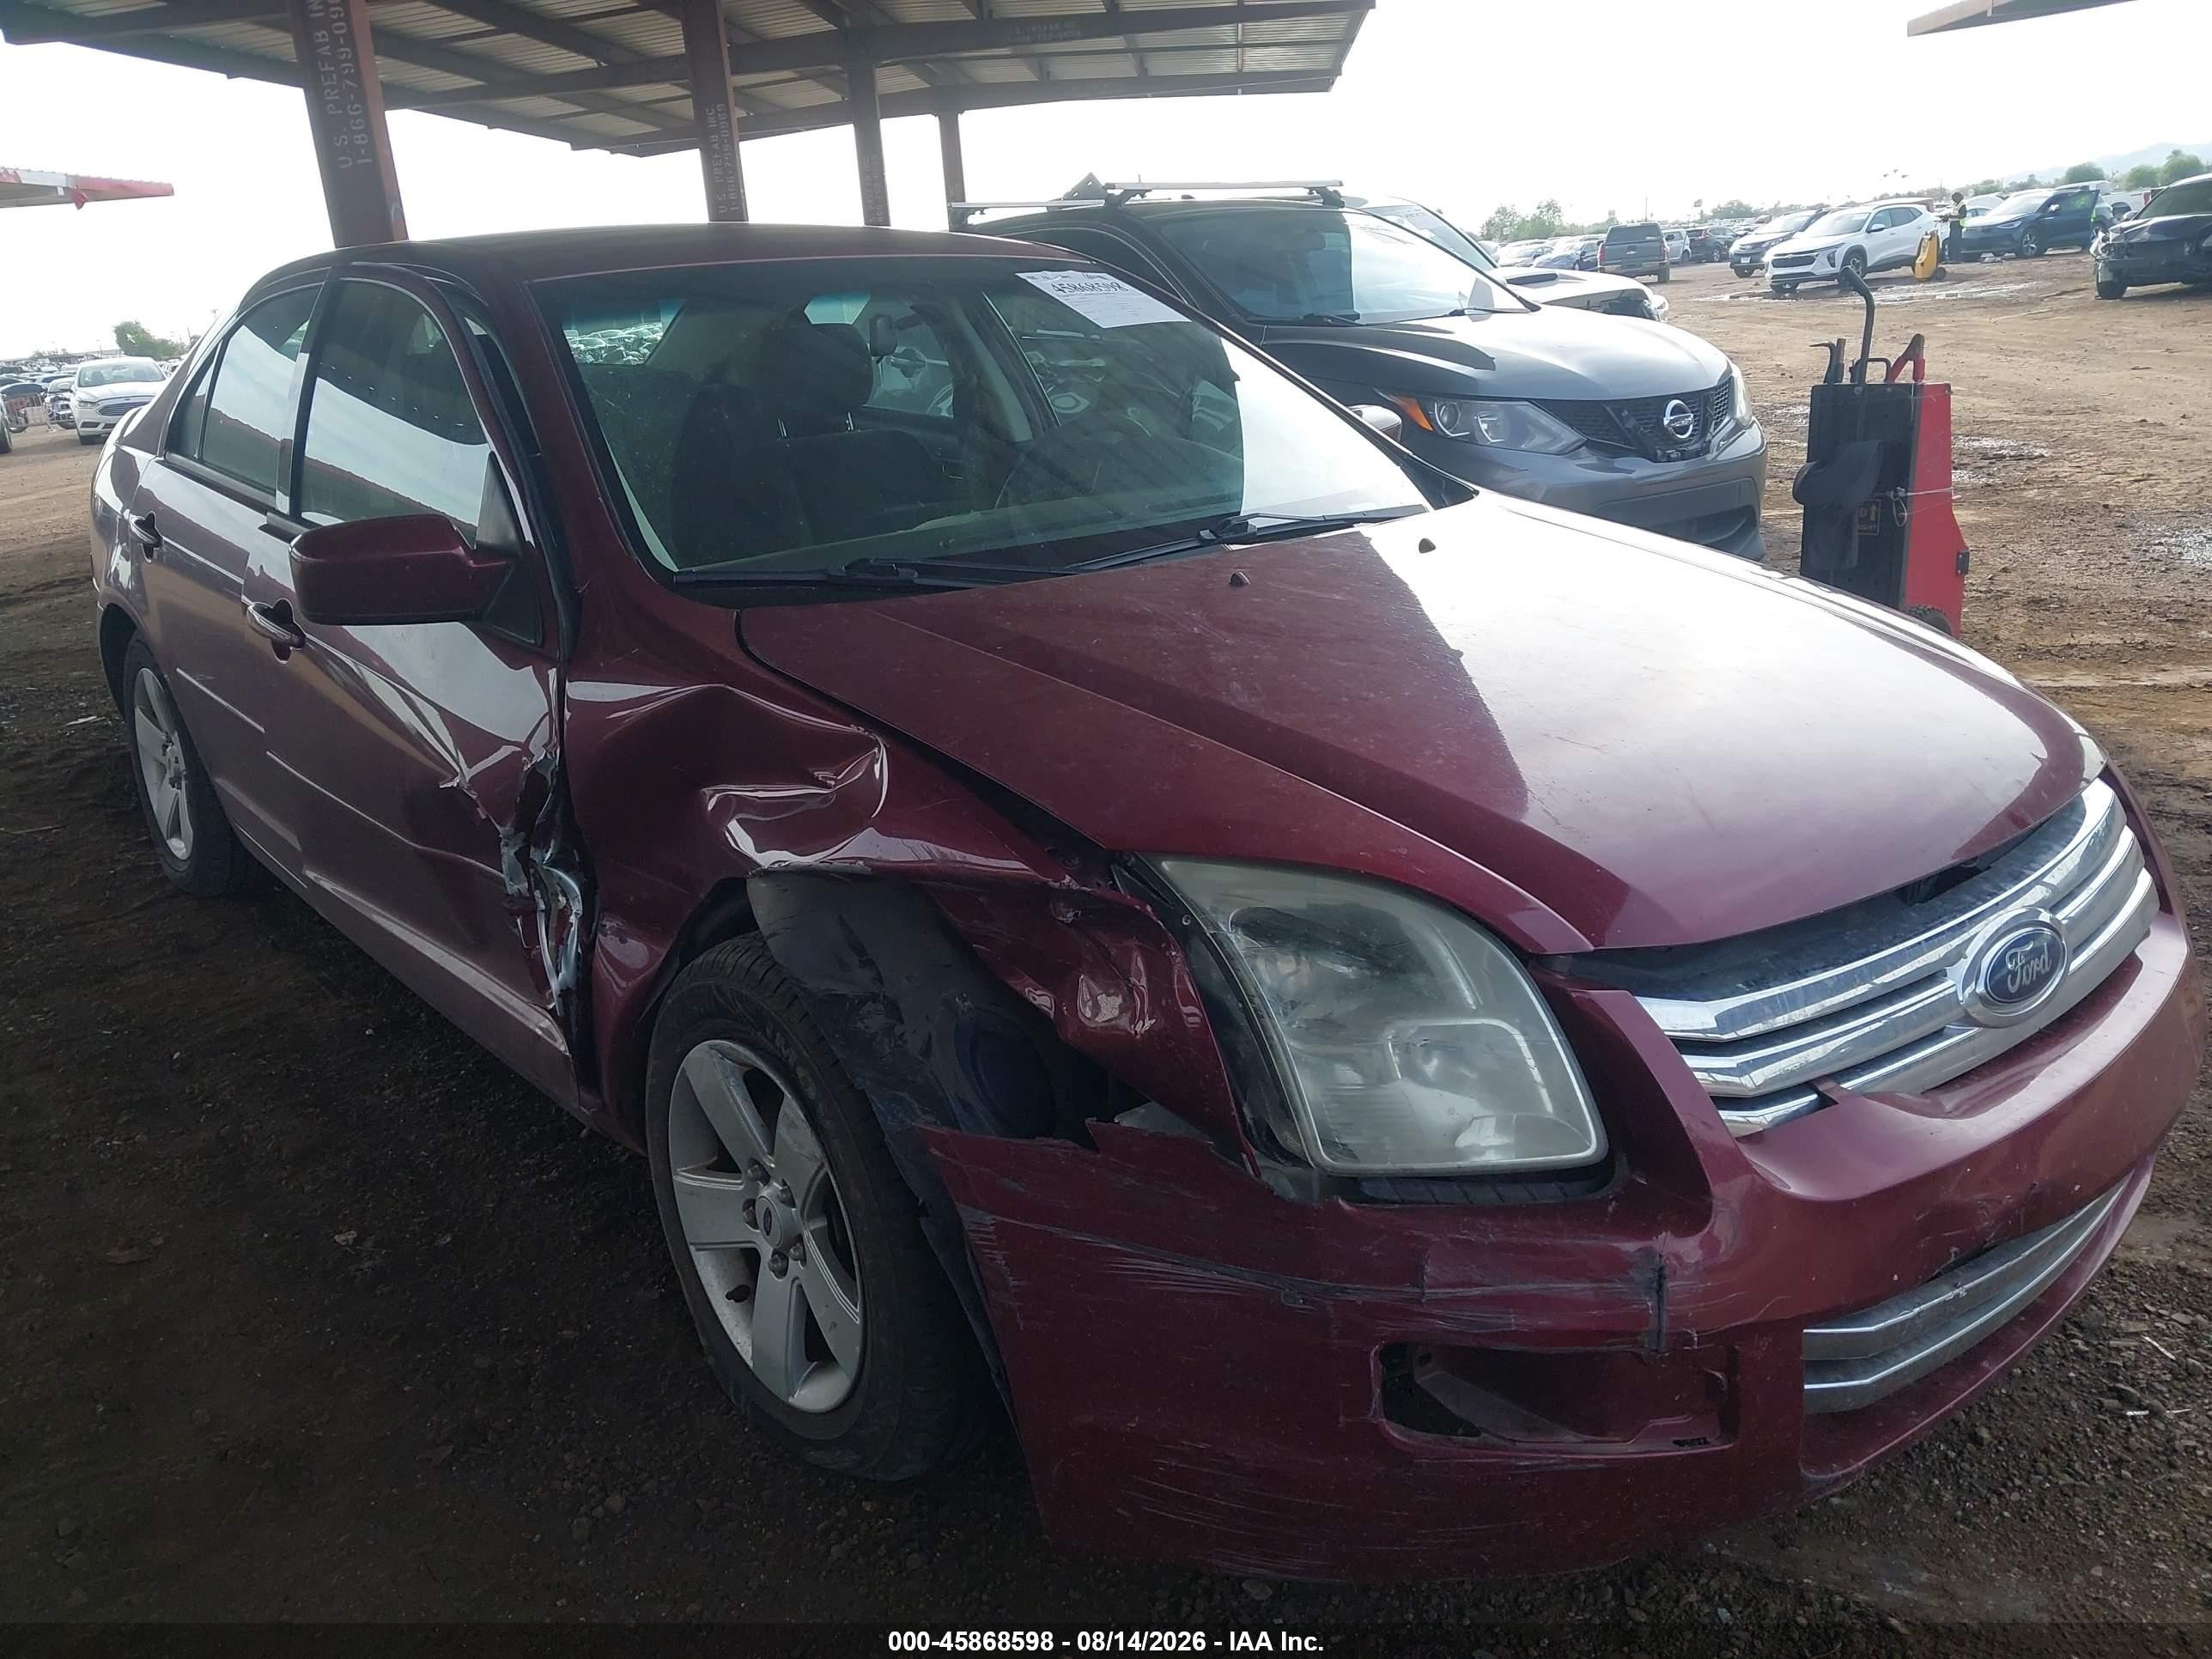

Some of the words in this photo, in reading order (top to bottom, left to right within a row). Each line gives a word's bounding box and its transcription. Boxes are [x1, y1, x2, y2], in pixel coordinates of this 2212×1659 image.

[314, 30, 343, 115] PREFAB
[333, 128, 353, 168] U.S.
[709, 135, 724, 182] PREFAB
[1051, 282, 1129, 293] 45868598
[2005, 940, 2052, 994] Ford
